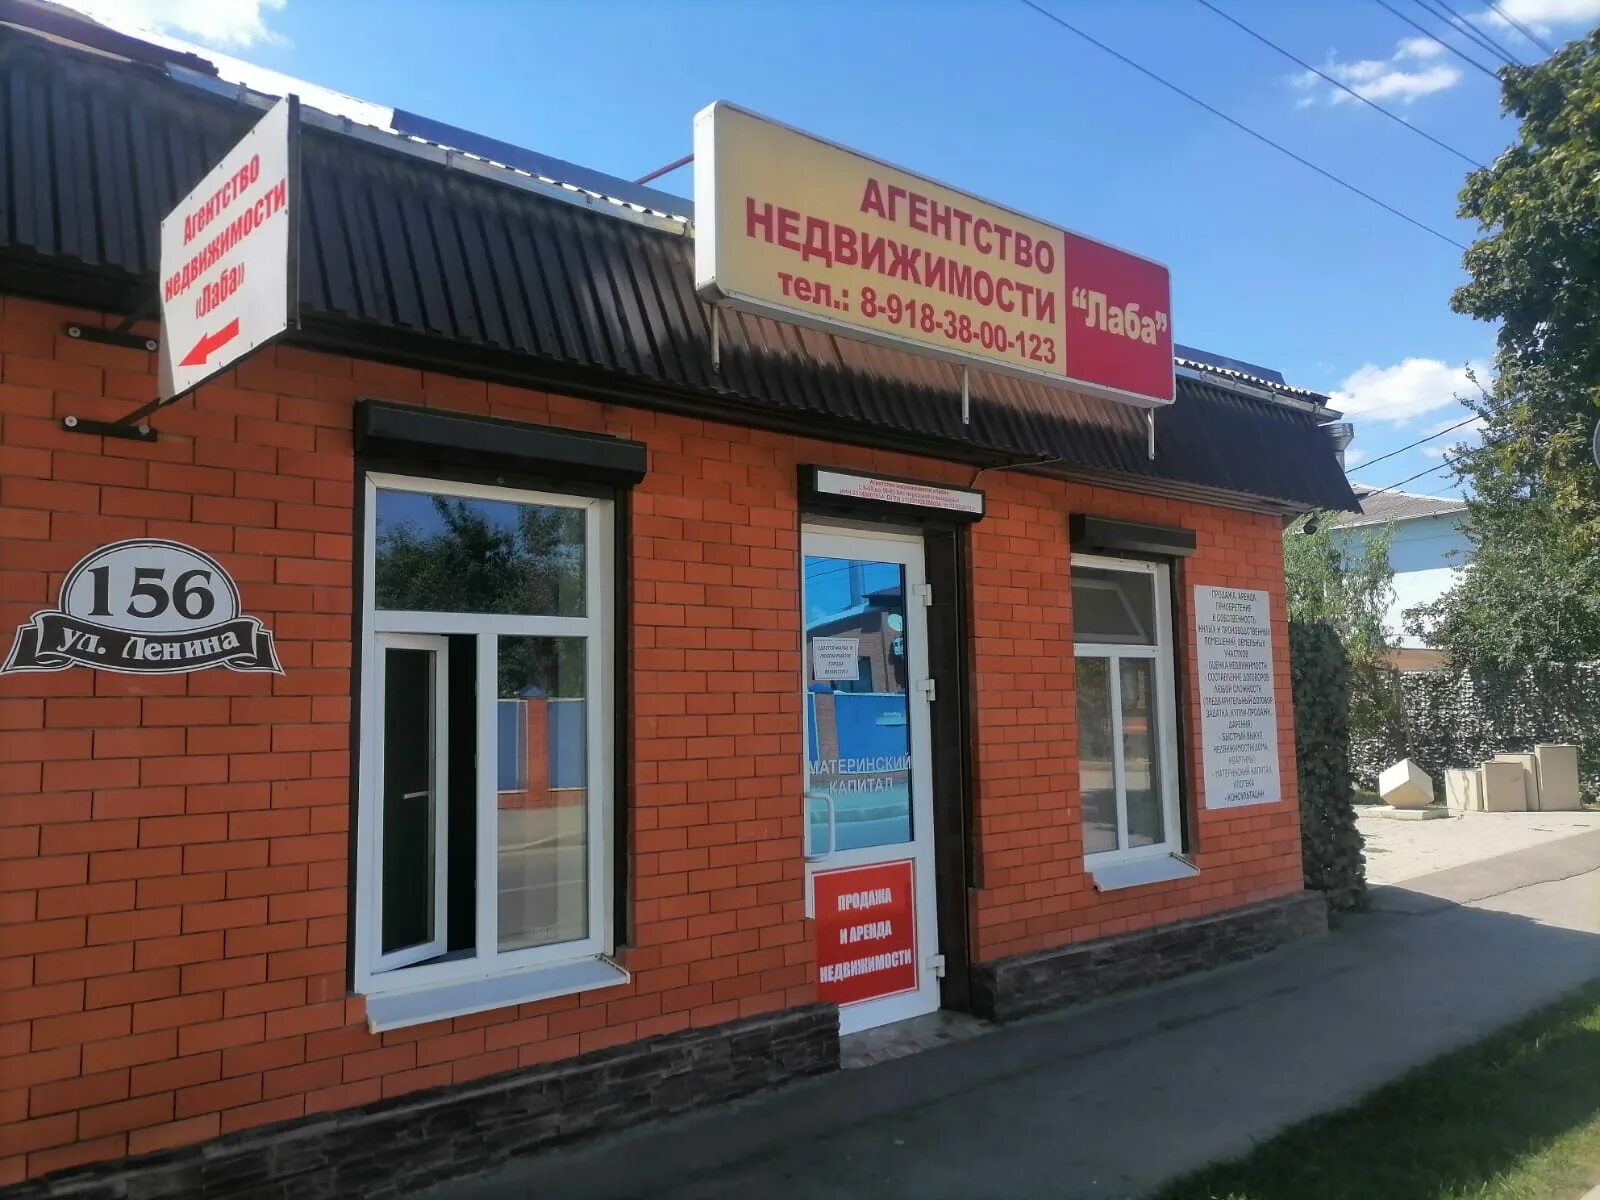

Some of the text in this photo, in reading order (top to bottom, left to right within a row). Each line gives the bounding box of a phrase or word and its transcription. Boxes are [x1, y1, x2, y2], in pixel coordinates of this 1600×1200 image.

[184, 154, 260, 246] Агентство
[860, 178, 1055, 275] АГЕНТСТВО
[165, 177, 286, 303] недвижимости
[746, 197, 1055, 324] НЕДВИЖИМОСТИ
[196, 262, 245, 319] «Лаба»
[778, 272, 1056, 365] тел.: 8-918-38-00-123
[88, 565, 215, 620] 156
[56, 627, 240, 660] ул. Ленина
[809, 752, 911, 775] МАТЕРИНСКИЙ
[829, 777, 893, 794] КАПИТАЛ
[837, 888, 892, 911] ПРОДАЖА
[840, 920, 892, 945] И АРЕНДА
[820, 948, 912, 984] НЕДВИЖИМОСТИ
